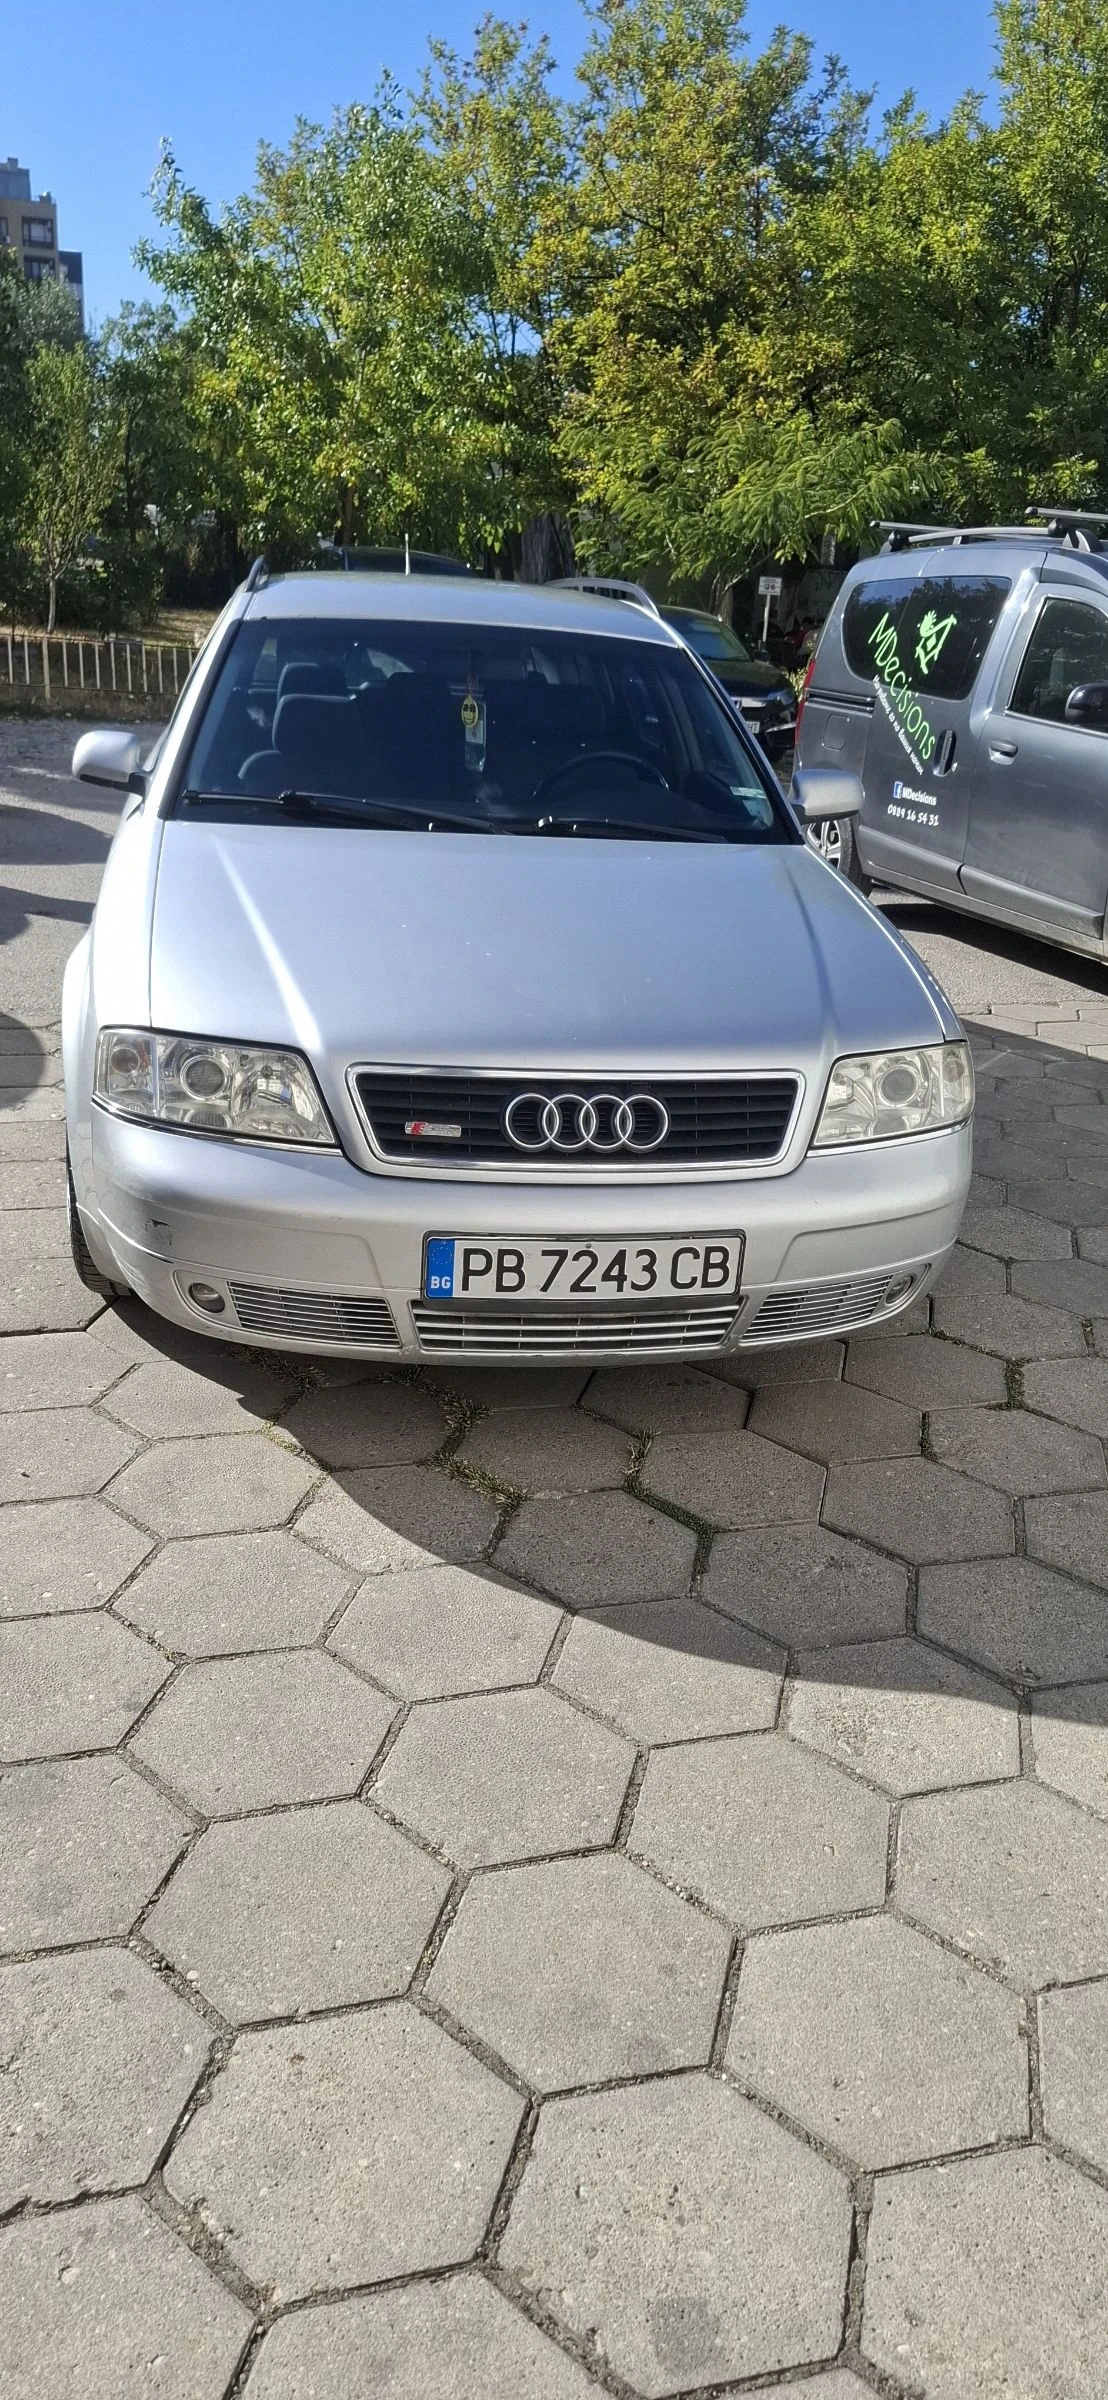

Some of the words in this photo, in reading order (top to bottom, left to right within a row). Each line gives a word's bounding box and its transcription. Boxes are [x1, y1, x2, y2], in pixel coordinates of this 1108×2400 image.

[868, 612, 935, 760] MDecisions
[902, 786, 937, 806] MDecisions
[906, 809, 916, 822] 16
[917, 812, 928, 825] 54
[928, 814, 940, 827] 31
[461, 1247, 526, 1293] PB
[539, 1248, 658, 1293] 7243
[670, 1245, 730, 1290] CB
[430, 1275, 451, 1289] BG
